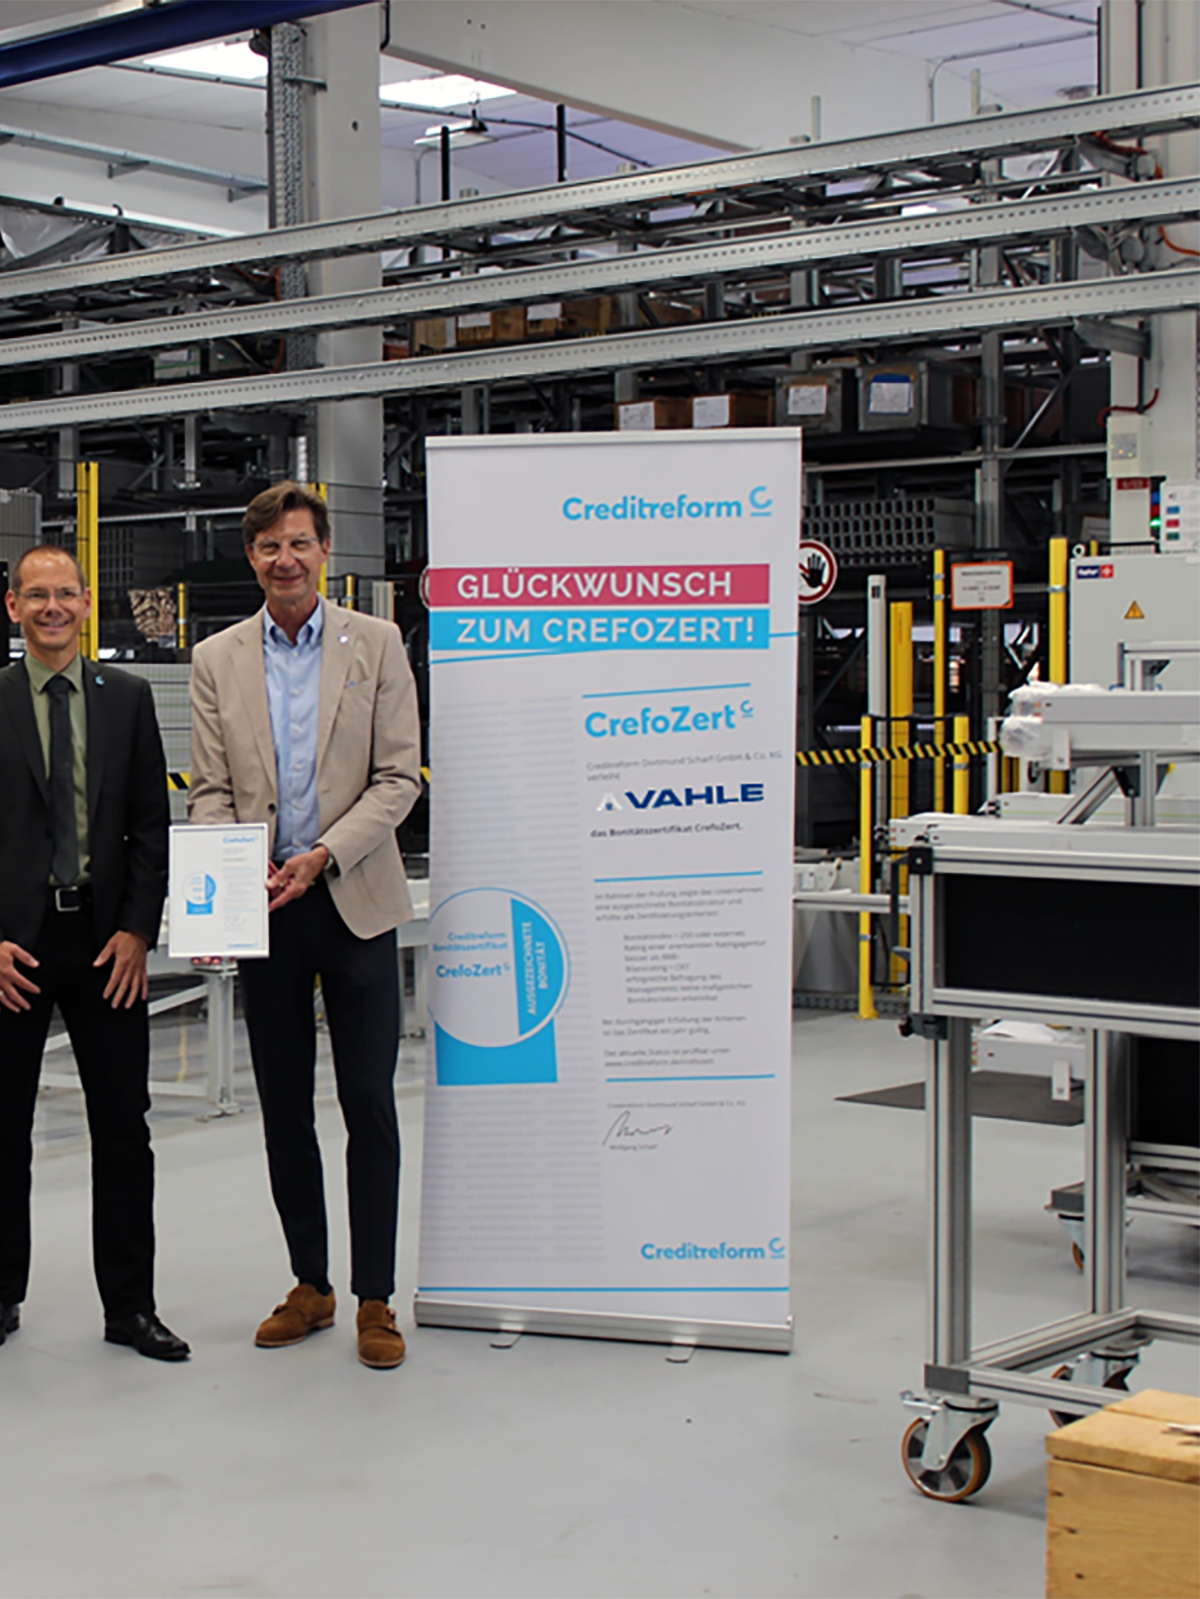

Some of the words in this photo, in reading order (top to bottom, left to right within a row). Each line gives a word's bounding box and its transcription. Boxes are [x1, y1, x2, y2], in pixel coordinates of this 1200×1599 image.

[562, 494, 742, 521] Creditreform
[456, 567, 732, 599] GLÜCKWUNSCH
[456, 618, 531, 644] ZUM
[542, 616, 754, 644] CREFOZERT!
[585, 704, 736, 739] CrefoZert
[625, 783, 764, 809] VAHLE
[590, 828, 607, 838] das
[436, 964, 503, 979] CrefoZert
[641, 1242, 765, 1260] Creditreform
